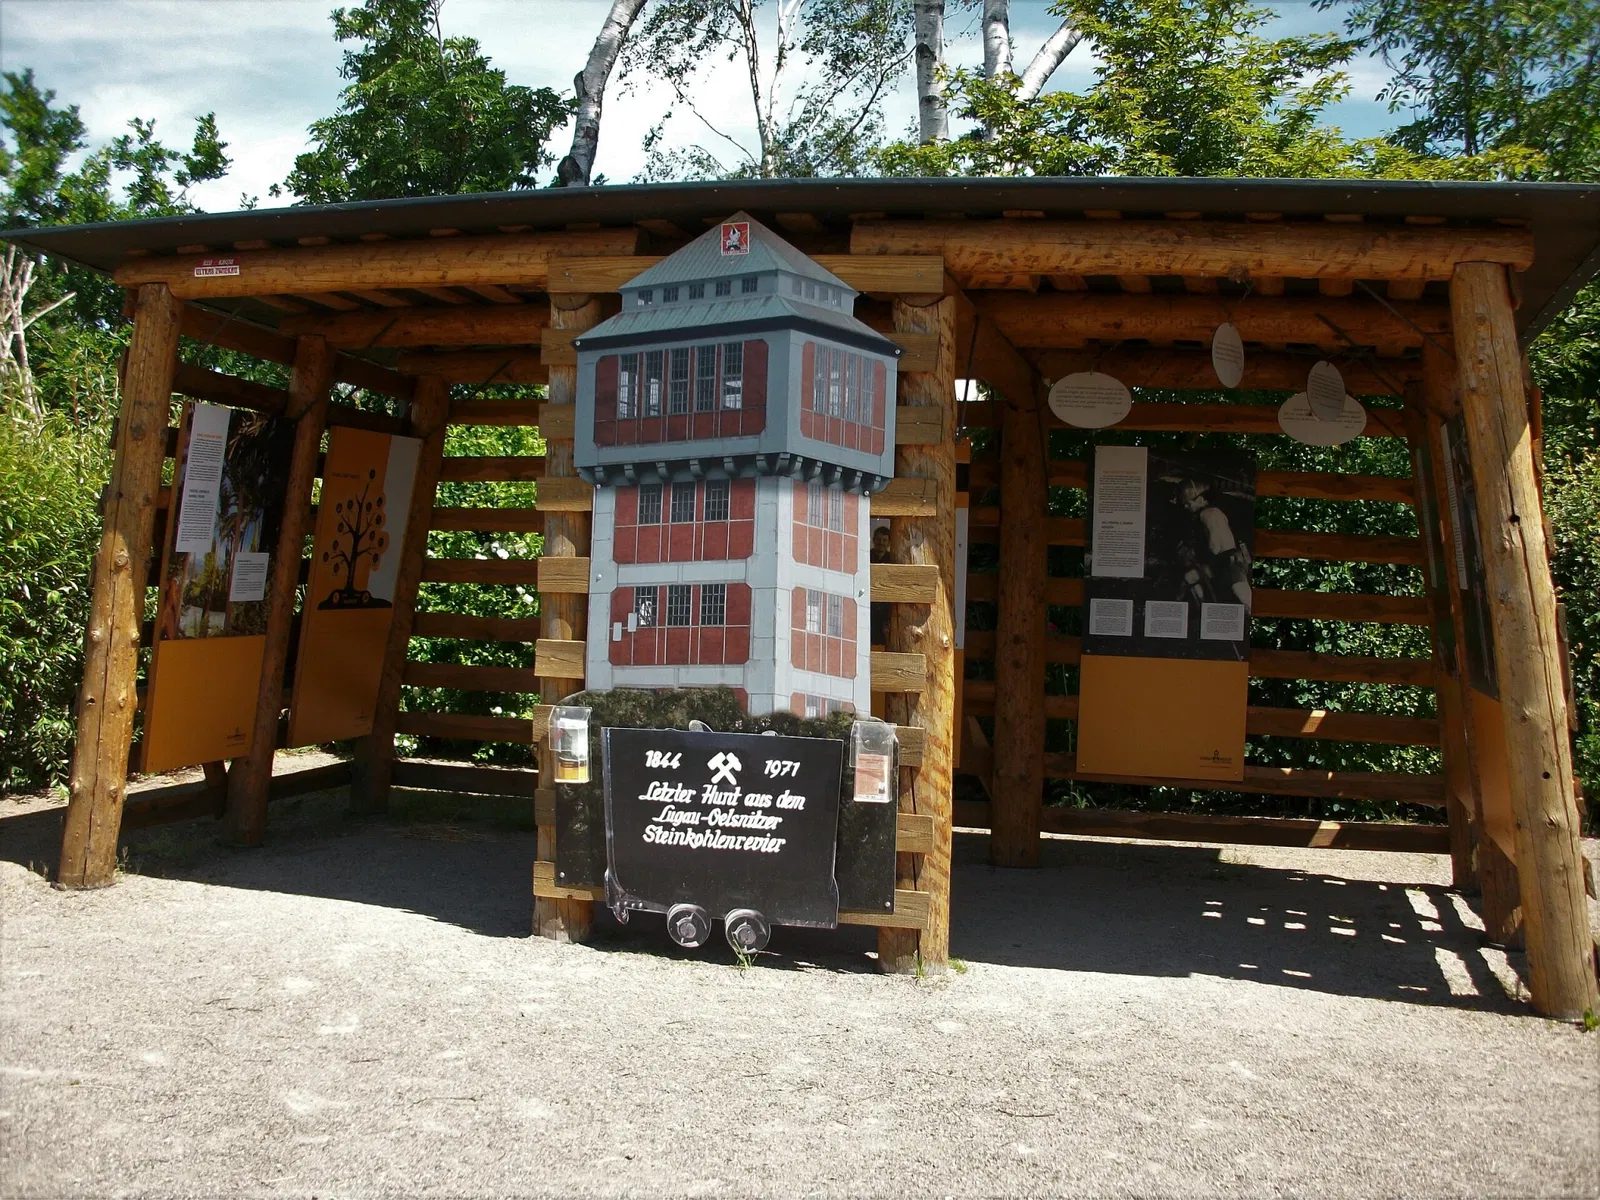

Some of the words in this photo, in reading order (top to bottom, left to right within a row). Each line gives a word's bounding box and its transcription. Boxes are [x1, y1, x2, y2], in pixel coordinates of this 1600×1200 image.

[645, 750, 683, 769] 1844
[763, 760, 801, 778] 1971
[638, 781, 697, 804] Letzter
[700, 784, 743, 806] Hunt
[743, 793, 773, 808] aus
[775, 789, 806, 810] dem
[652, 804, 783, 830] Lugau-Oelsnitzer
[642, 824, 787, 853] Steinkohlenrevier
